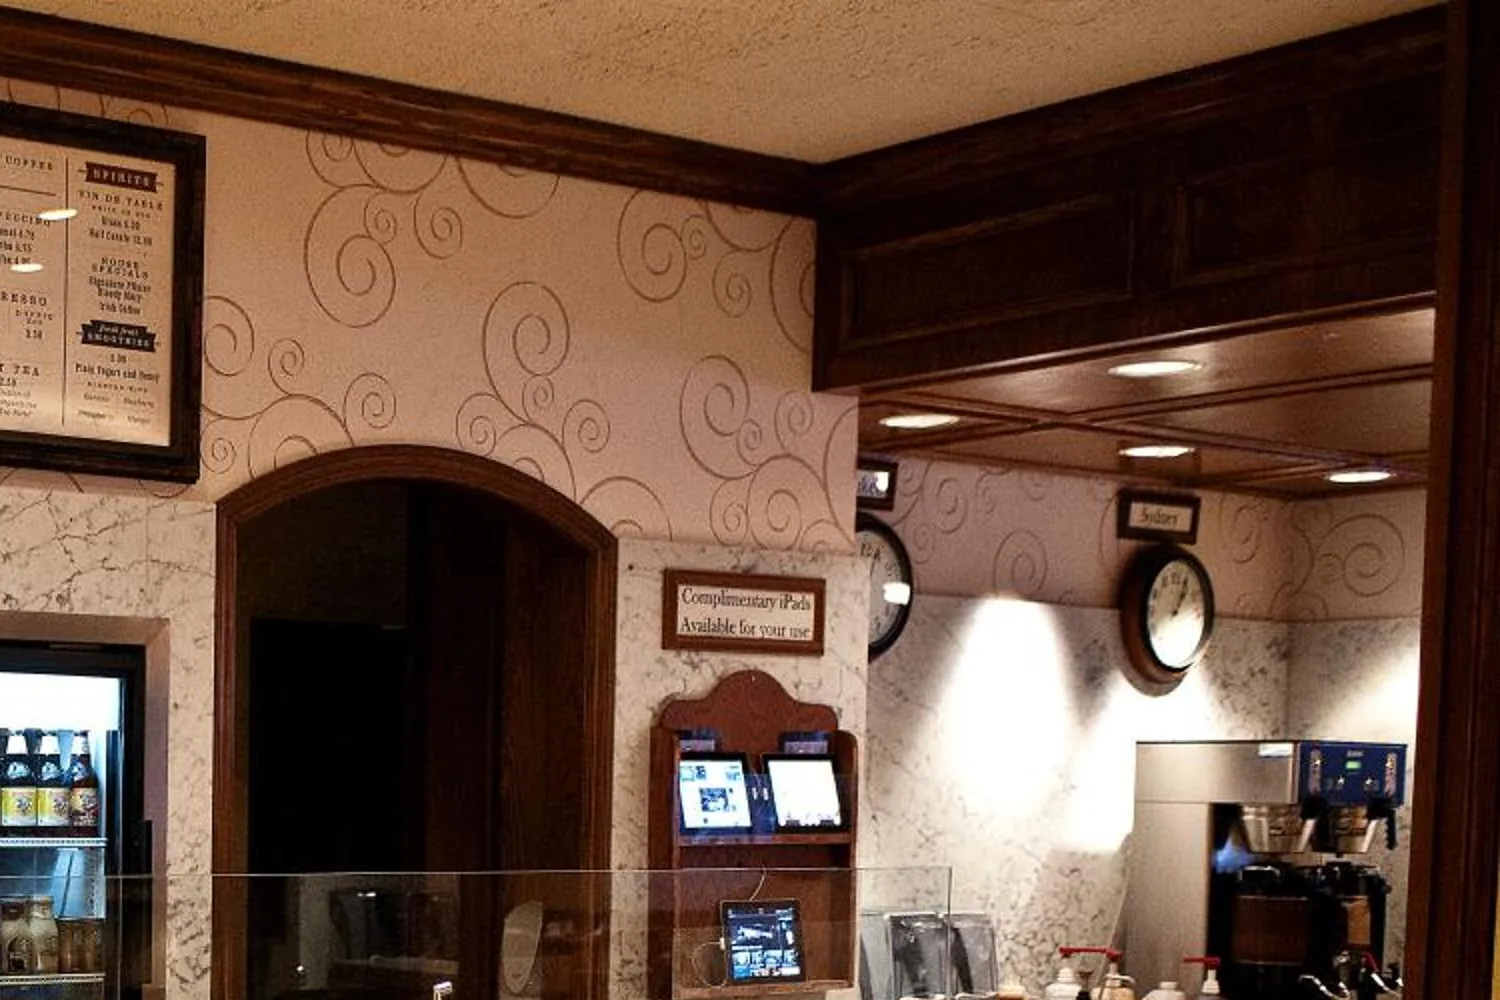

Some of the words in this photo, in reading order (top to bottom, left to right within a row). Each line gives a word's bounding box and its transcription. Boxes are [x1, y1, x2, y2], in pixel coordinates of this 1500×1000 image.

[6, 155, 52, 170] COFFEE
[681, 587, 777, 613] Complimentary
[779, 592, 812, 611] iPads
[680, 617, 735, 635] Available
[739, 618, 756, 636] for
[758, 623, 786, 640] your
[789, 627, 811, 638] use
